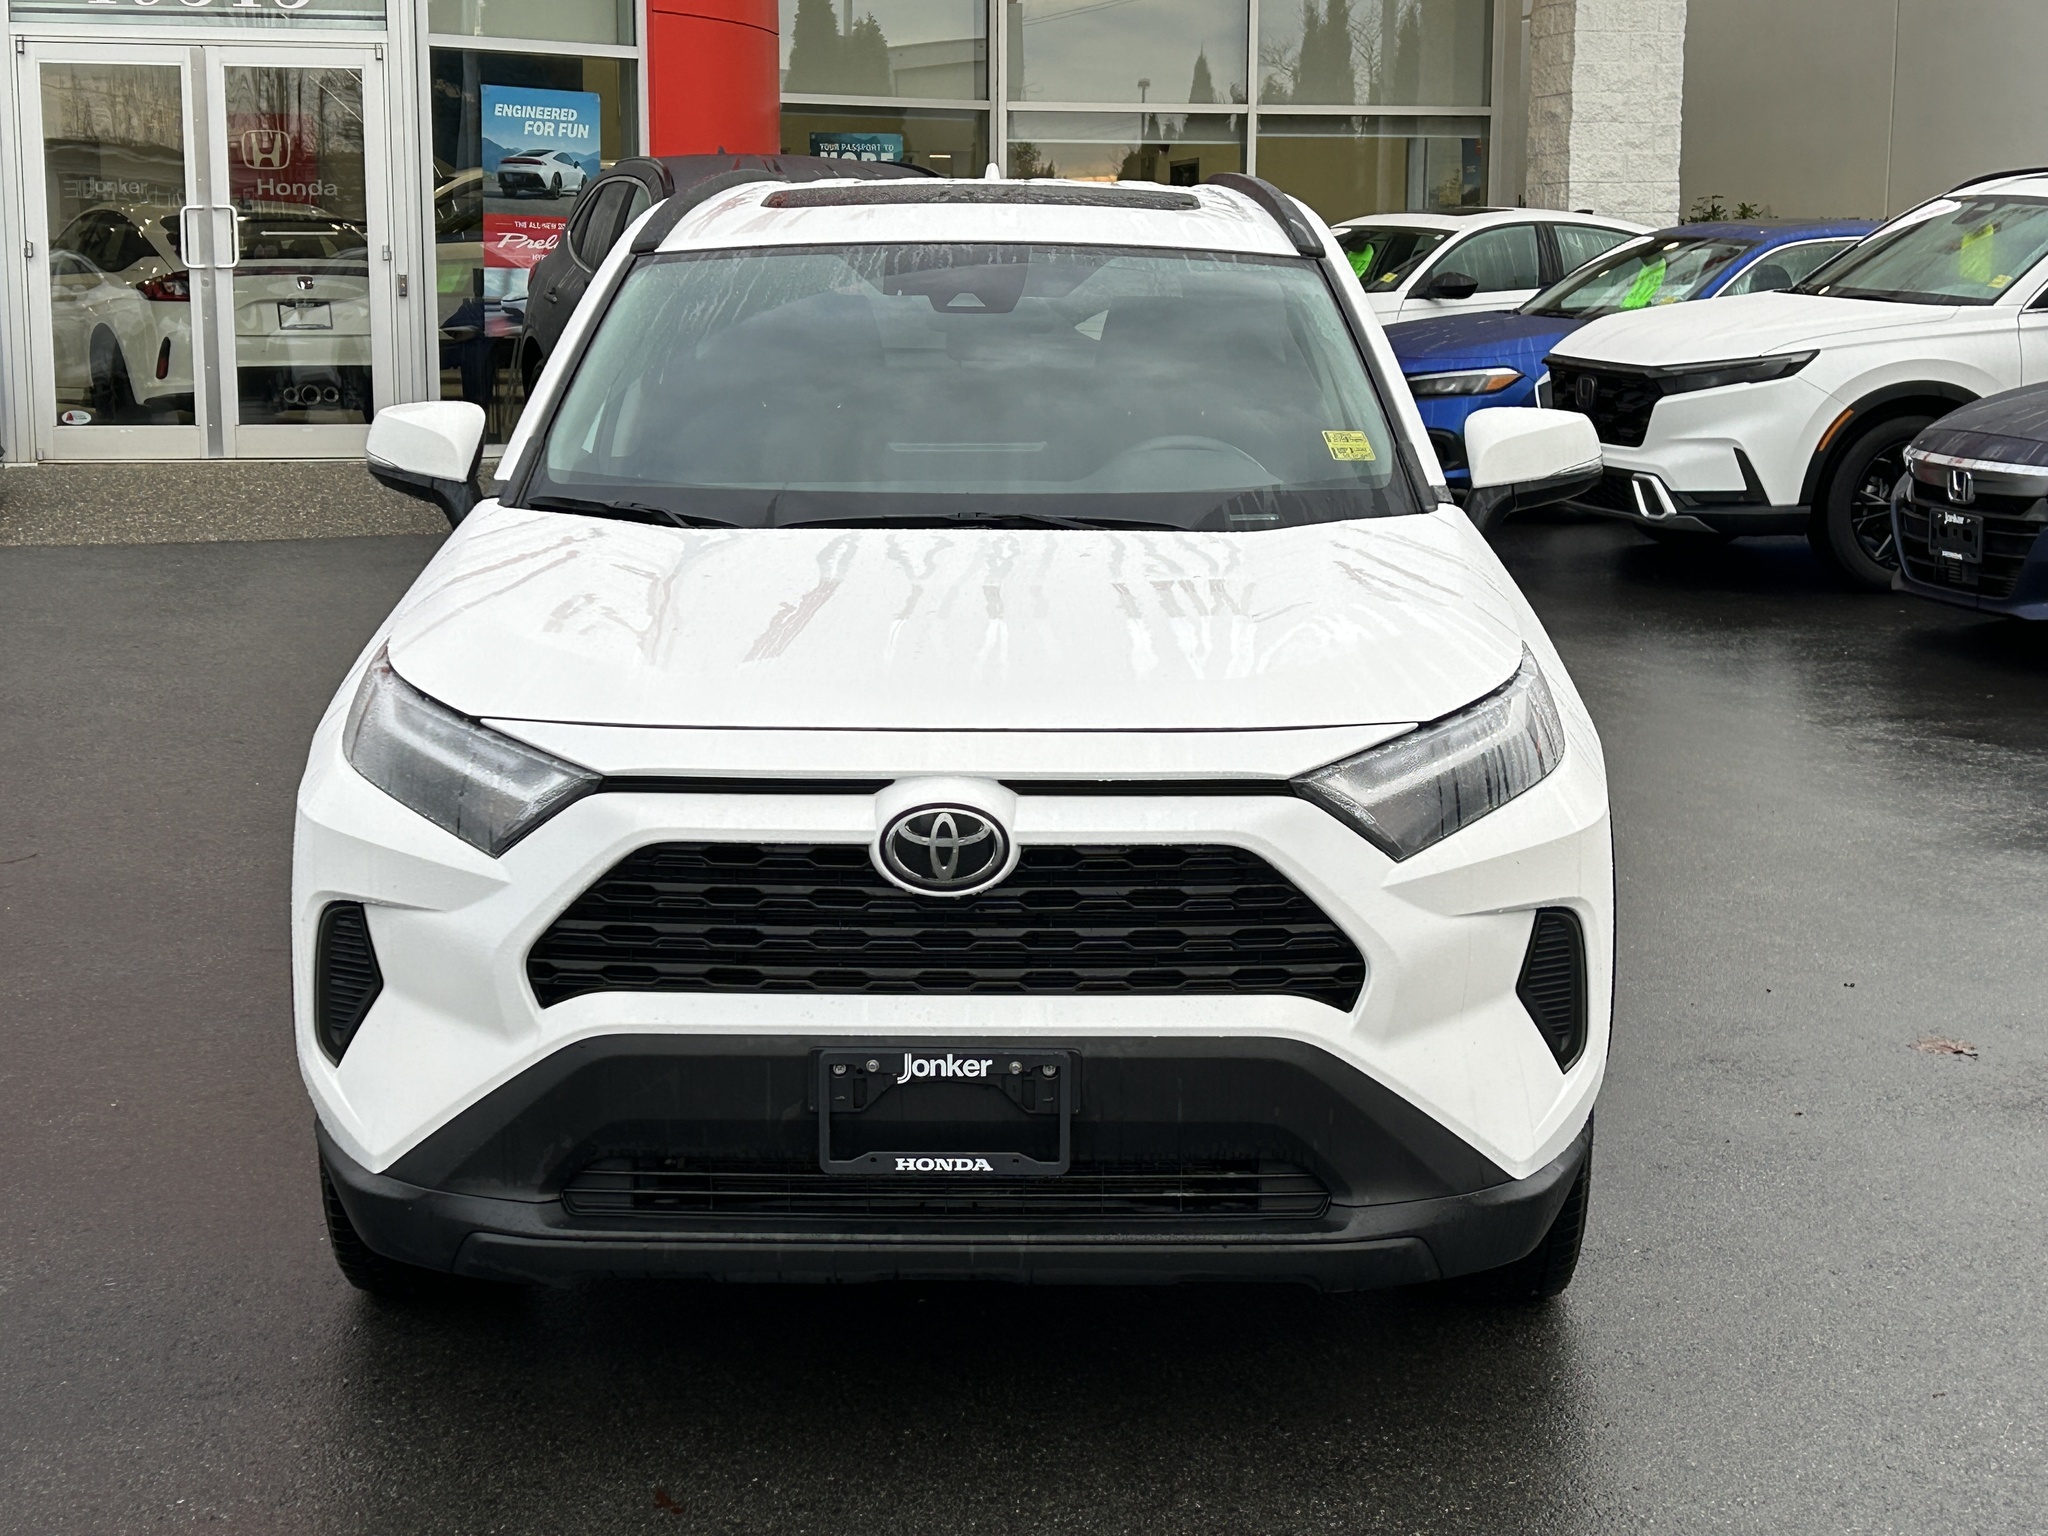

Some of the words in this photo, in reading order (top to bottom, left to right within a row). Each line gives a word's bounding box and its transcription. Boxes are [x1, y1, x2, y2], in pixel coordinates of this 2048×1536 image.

[494, 103, 578, 121] ENGINEERED
[524, 121, 555, 137] FOR
[558, 123, 589, 138] FUN
[819, 143, 839, 151] YOUR
[841, 143, 881, 152] PASSPORT
[884, 144, 894, 152] TO
[84, 177, 148, 198] Jonker
[257, 178, 338, 196] Honda
[897, 1053, 993, 1084] Jonker
[895, 1158, 993, 1171] HONDA
